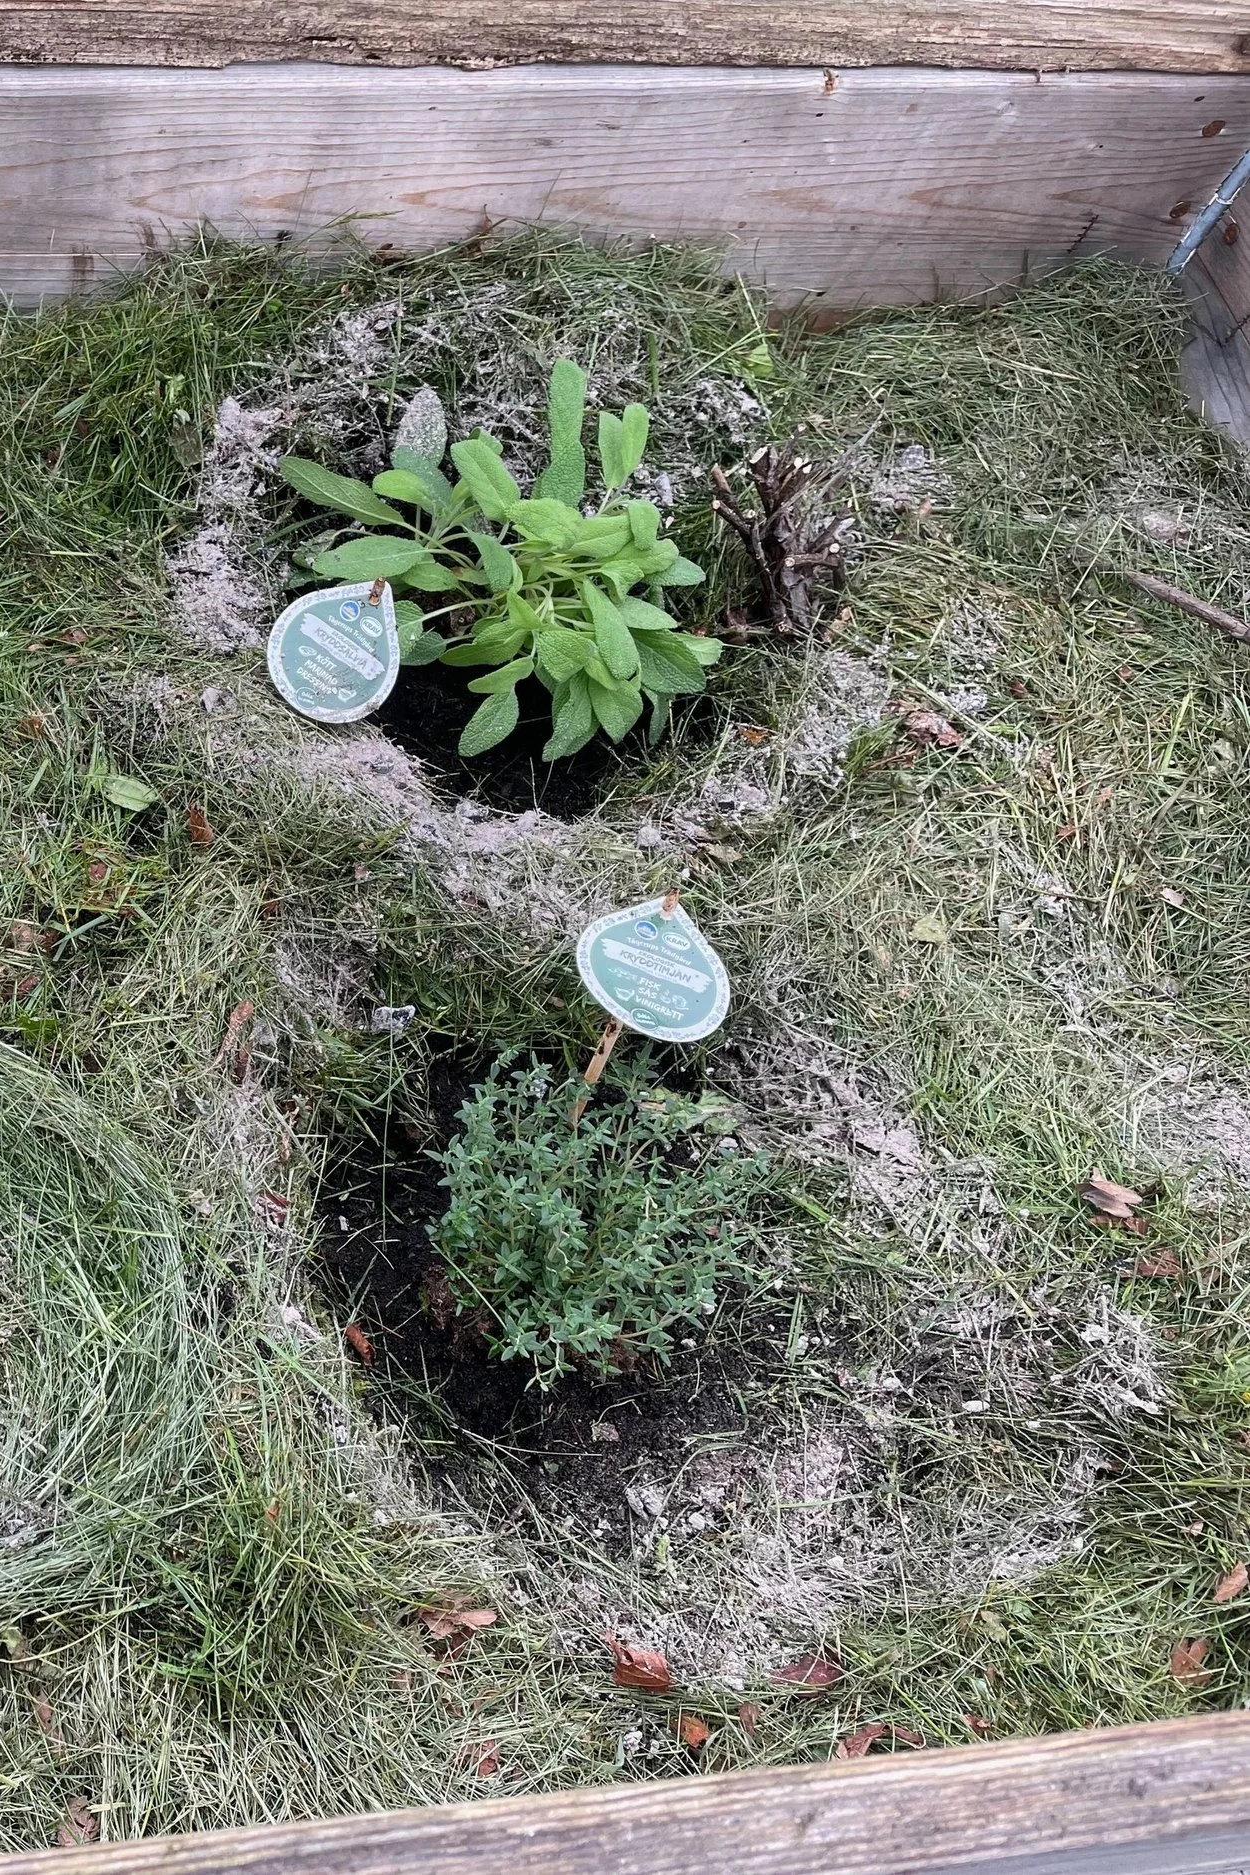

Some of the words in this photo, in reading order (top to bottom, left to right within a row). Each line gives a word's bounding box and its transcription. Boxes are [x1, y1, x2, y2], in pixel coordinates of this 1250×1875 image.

[315, 628, 367, 669] KRYDDSALVIA
[315, 654, 338, 671] KÖTT
[304, 660, 338, 685] MARINAD
[666, 937, 688, 949] KRAV
[620, 949, 692, 984] KRYDDTIMJAN
[638, 986, 657, 999] SÅS
[639, 978, 662, 991] FISK
